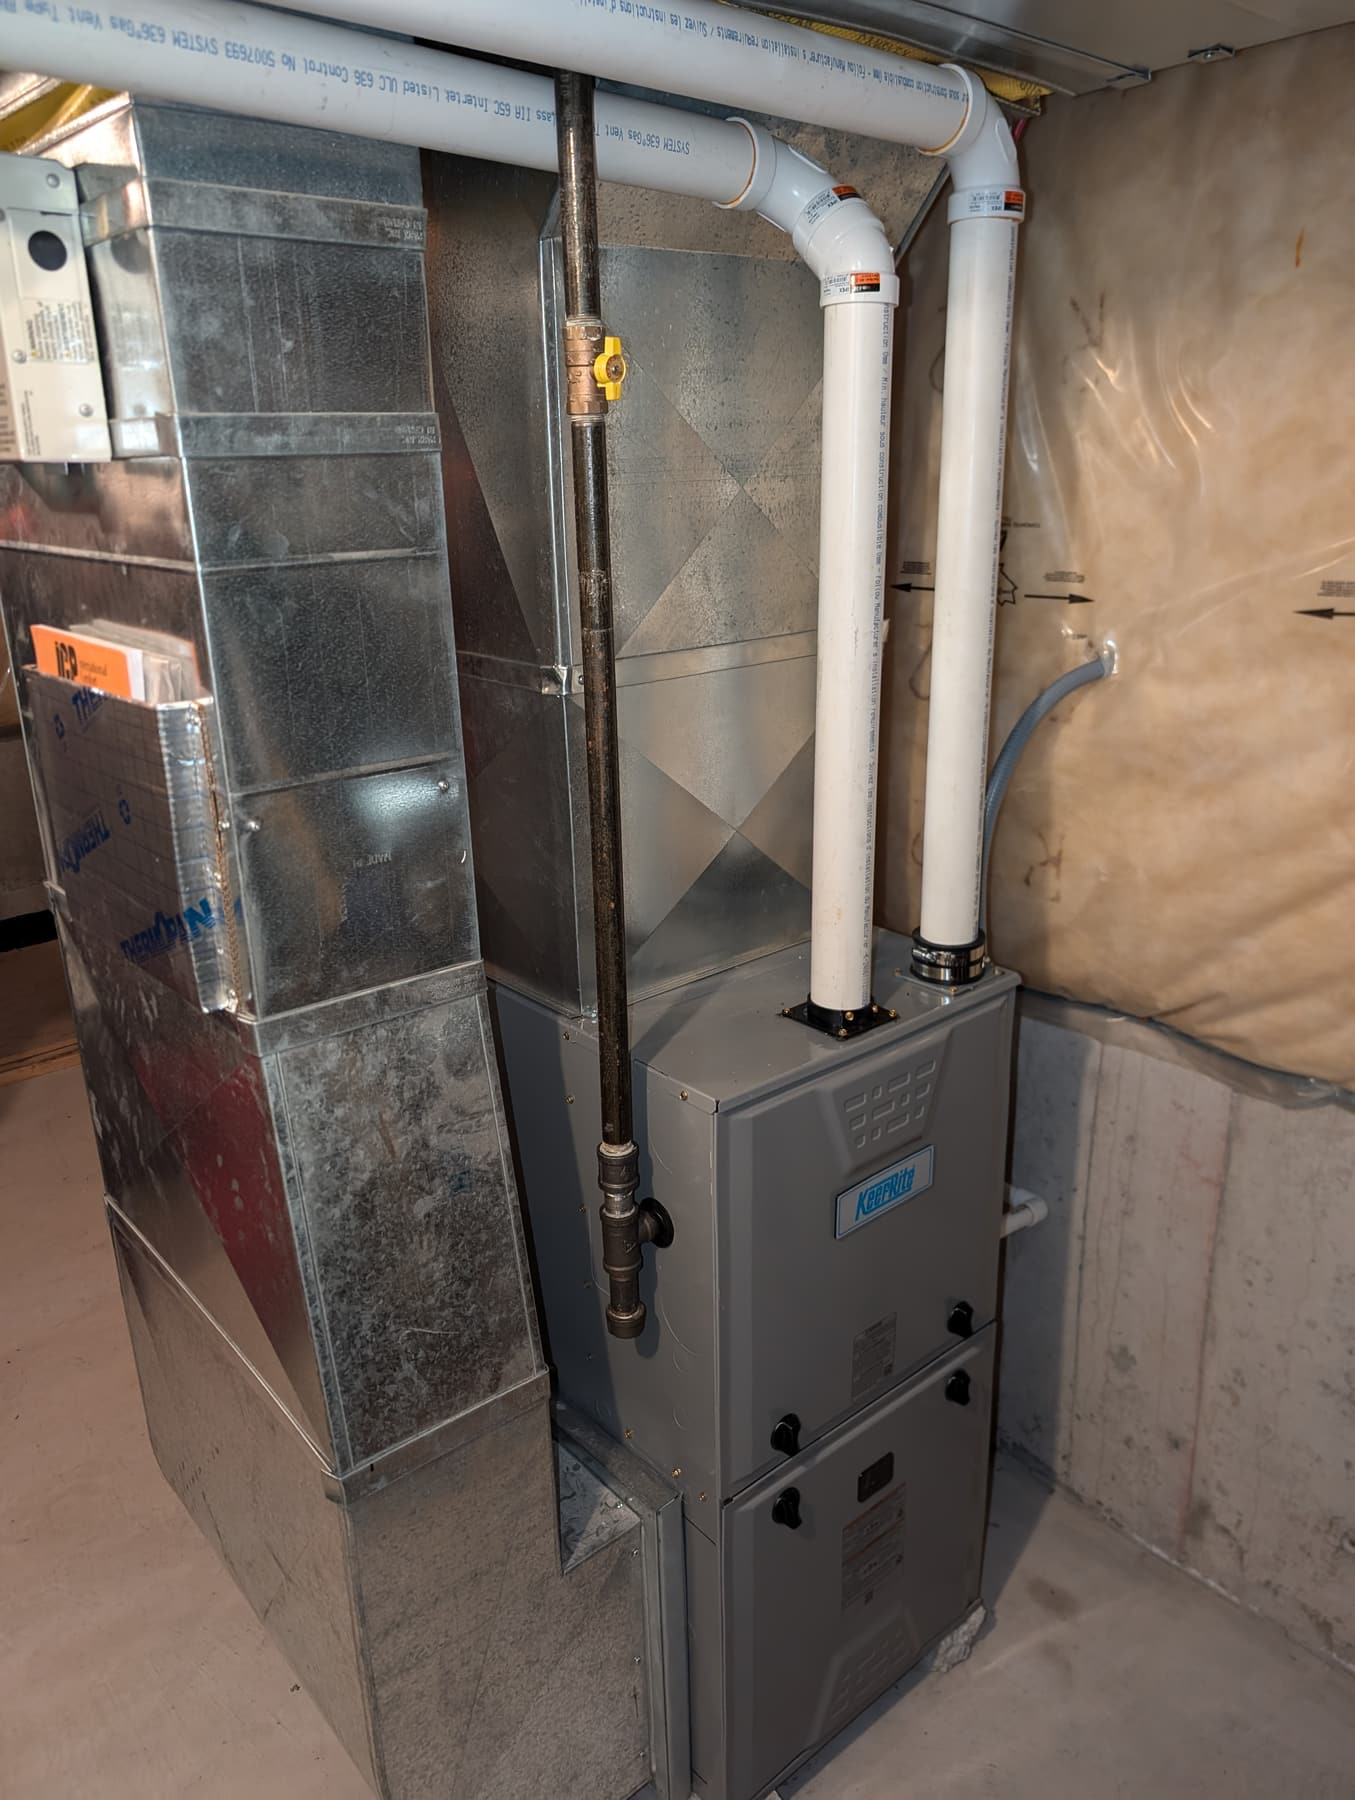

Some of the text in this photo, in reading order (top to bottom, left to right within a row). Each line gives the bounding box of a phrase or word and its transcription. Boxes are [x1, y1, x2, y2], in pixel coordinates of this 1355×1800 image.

[66, 6, 102, 31] Vent
[619, 1, 665, 26] instructions
[669, 13, 681, 31] les
[684, 16, 707, 38] Suivez
[171, 29, 218, 55] SYSTEM
[224, 40, 276, 67] 5007693
[761, 38, 800, 61] installation
[280, 52, 296, 71] No
[303, 57, 348, 82] Control
[353, 69, 373, 87] 636
[378, 75, 397, 92] ULC
[402, 80, 440, 101] Listed
[444, 89, 488, 112] Intertek
[605, 122, 624, 141] Vent
[662, 136, 690, 156] SYSTEM
[879, 397, 887, 426] hauteur
[877, 451, 885, 500] construction
